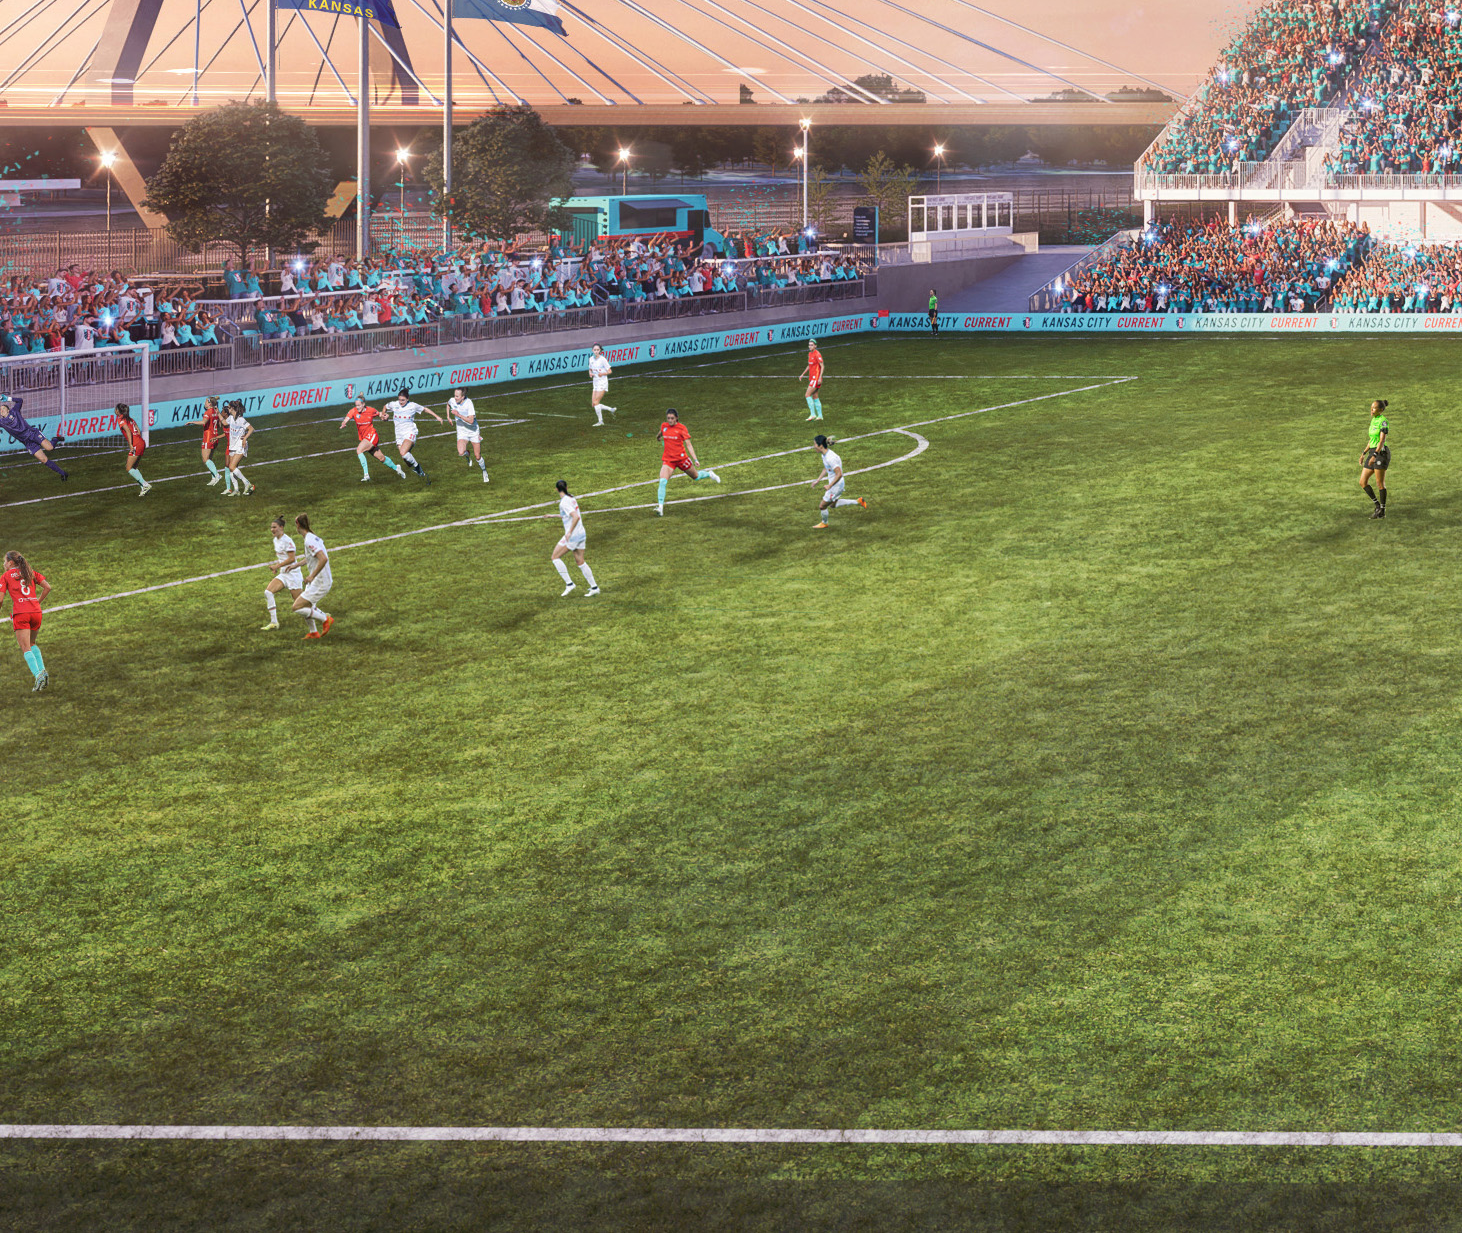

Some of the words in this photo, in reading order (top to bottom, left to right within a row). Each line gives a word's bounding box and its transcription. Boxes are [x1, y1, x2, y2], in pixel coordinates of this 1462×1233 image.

[781, 324, 810, 339] KANSAS
[812, 323, 829, 335] CITY
[832, 318, 863, 332] CURRENT
[889, 316, 930, 328] KANSAS
[964, 316, 1012, 328] CURRENT
[1042, 317, 1083, 328] KANSAS
[1088, 317, 1112, 328] CITY
[1118, 317, 1166, 328] CURRENT
[1196, 317, 1236, 328] KANSAS
[1242, 317, 1266, 328] CITY
[1271, 317, 1320, 328] CURRENT
[1350, 317, 1390, 328] KANSAS
[1396, 317, 1419, 328] CITY
[665, 338, 698, 355] KANSAS
[701, 336, 720, 351] CITY
[724, 331, 760, 347] CURRENT
[528, 357, 568, 374] KANSAS
[571, 353, 593, 370] CITY
[367, 375, 415, 396] KANSAS
[418, 372, 444, 389] CITY
[450, 365, 499, 385] CURRENT
[237, 395, 265, 413] ITY
[272, 386, 332, 408] CURRENT
[57, 415, 119, 437] CURREN
